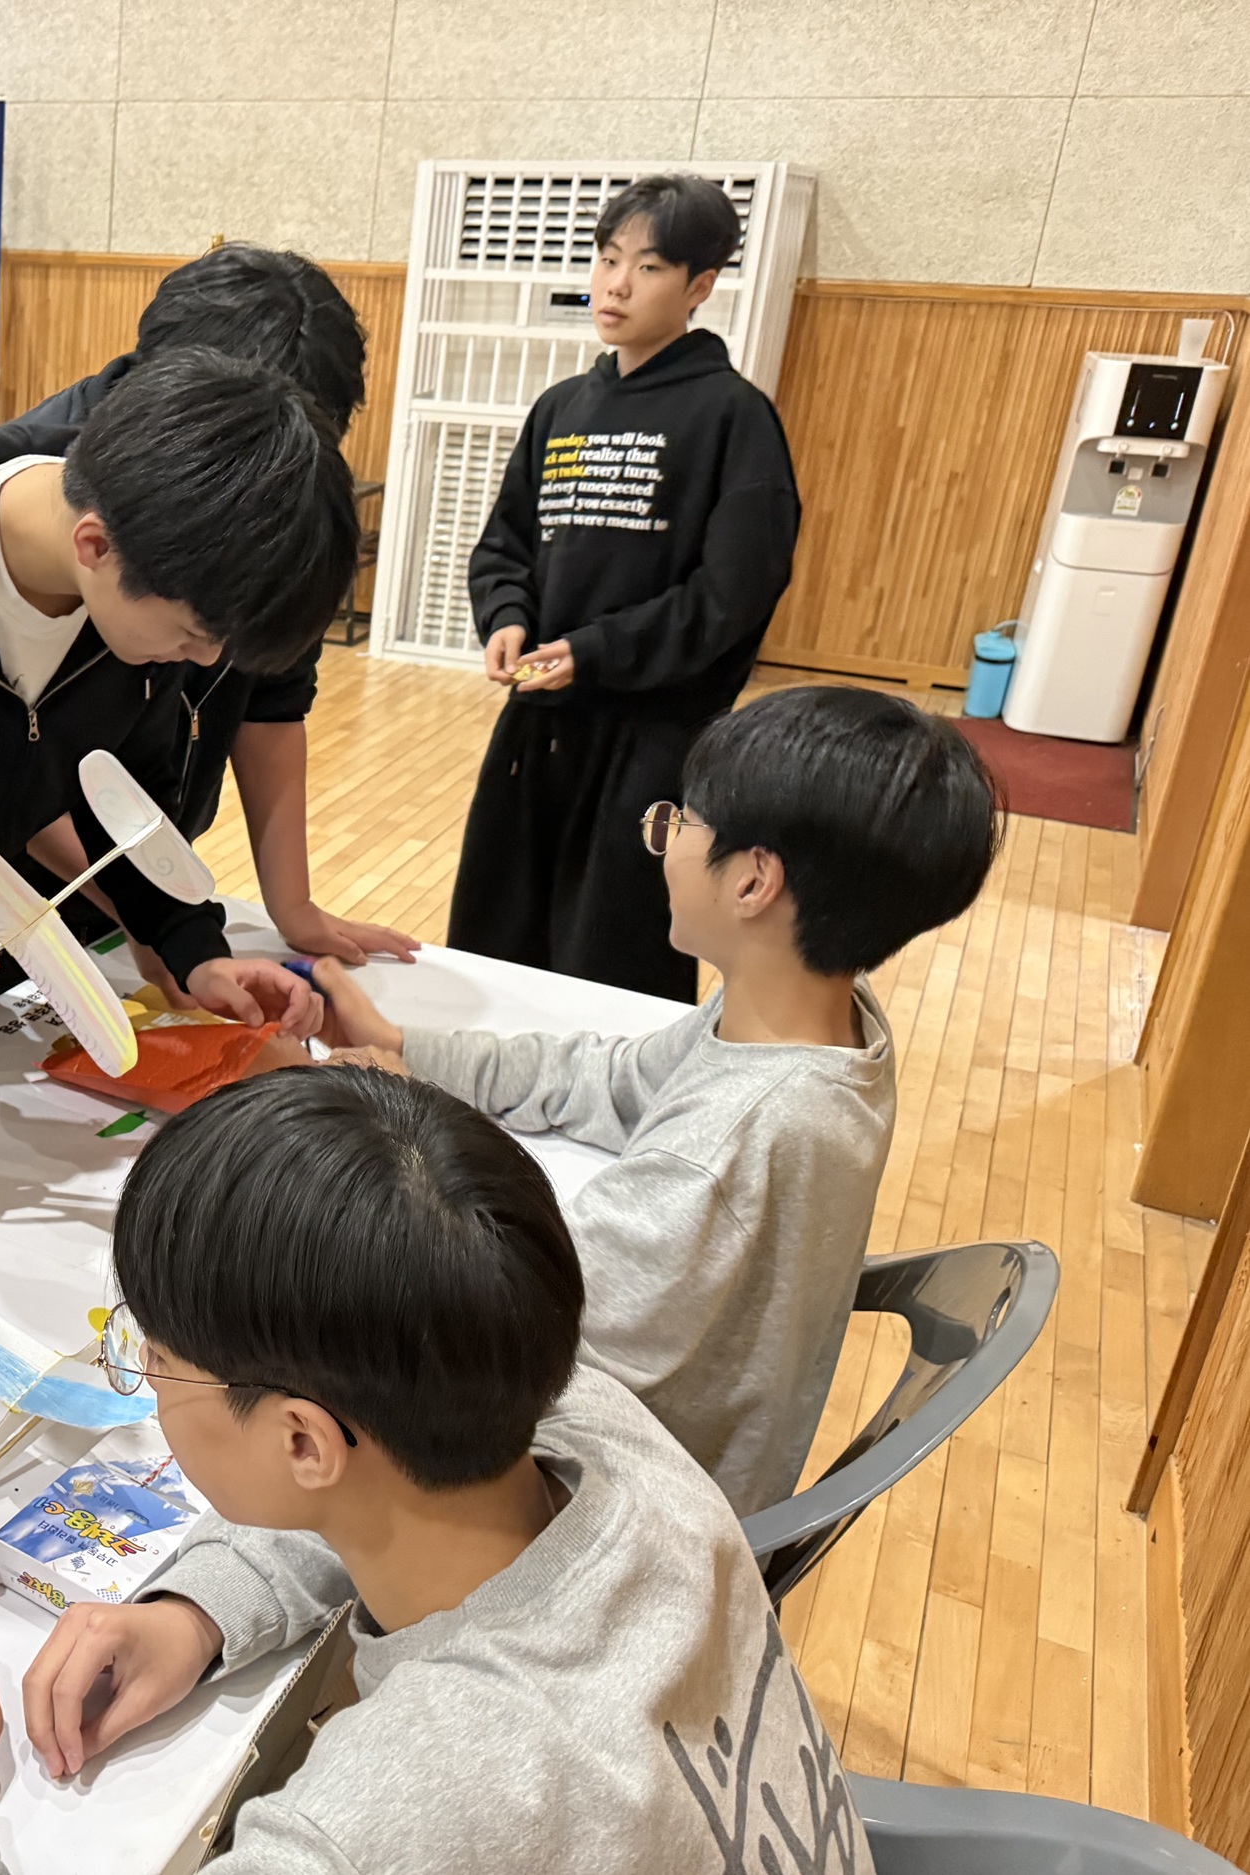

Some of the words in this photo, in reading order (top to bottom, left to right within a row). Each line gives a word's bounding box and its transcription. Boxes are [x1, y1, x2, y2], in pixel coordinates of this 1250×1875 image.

[611, 432, 636, 446] will
[635, 432, 667, 448] look
[578, 447, 625, 463] realize
[625, 447, 658, 464] that
[584, 464, 623, 480] every
